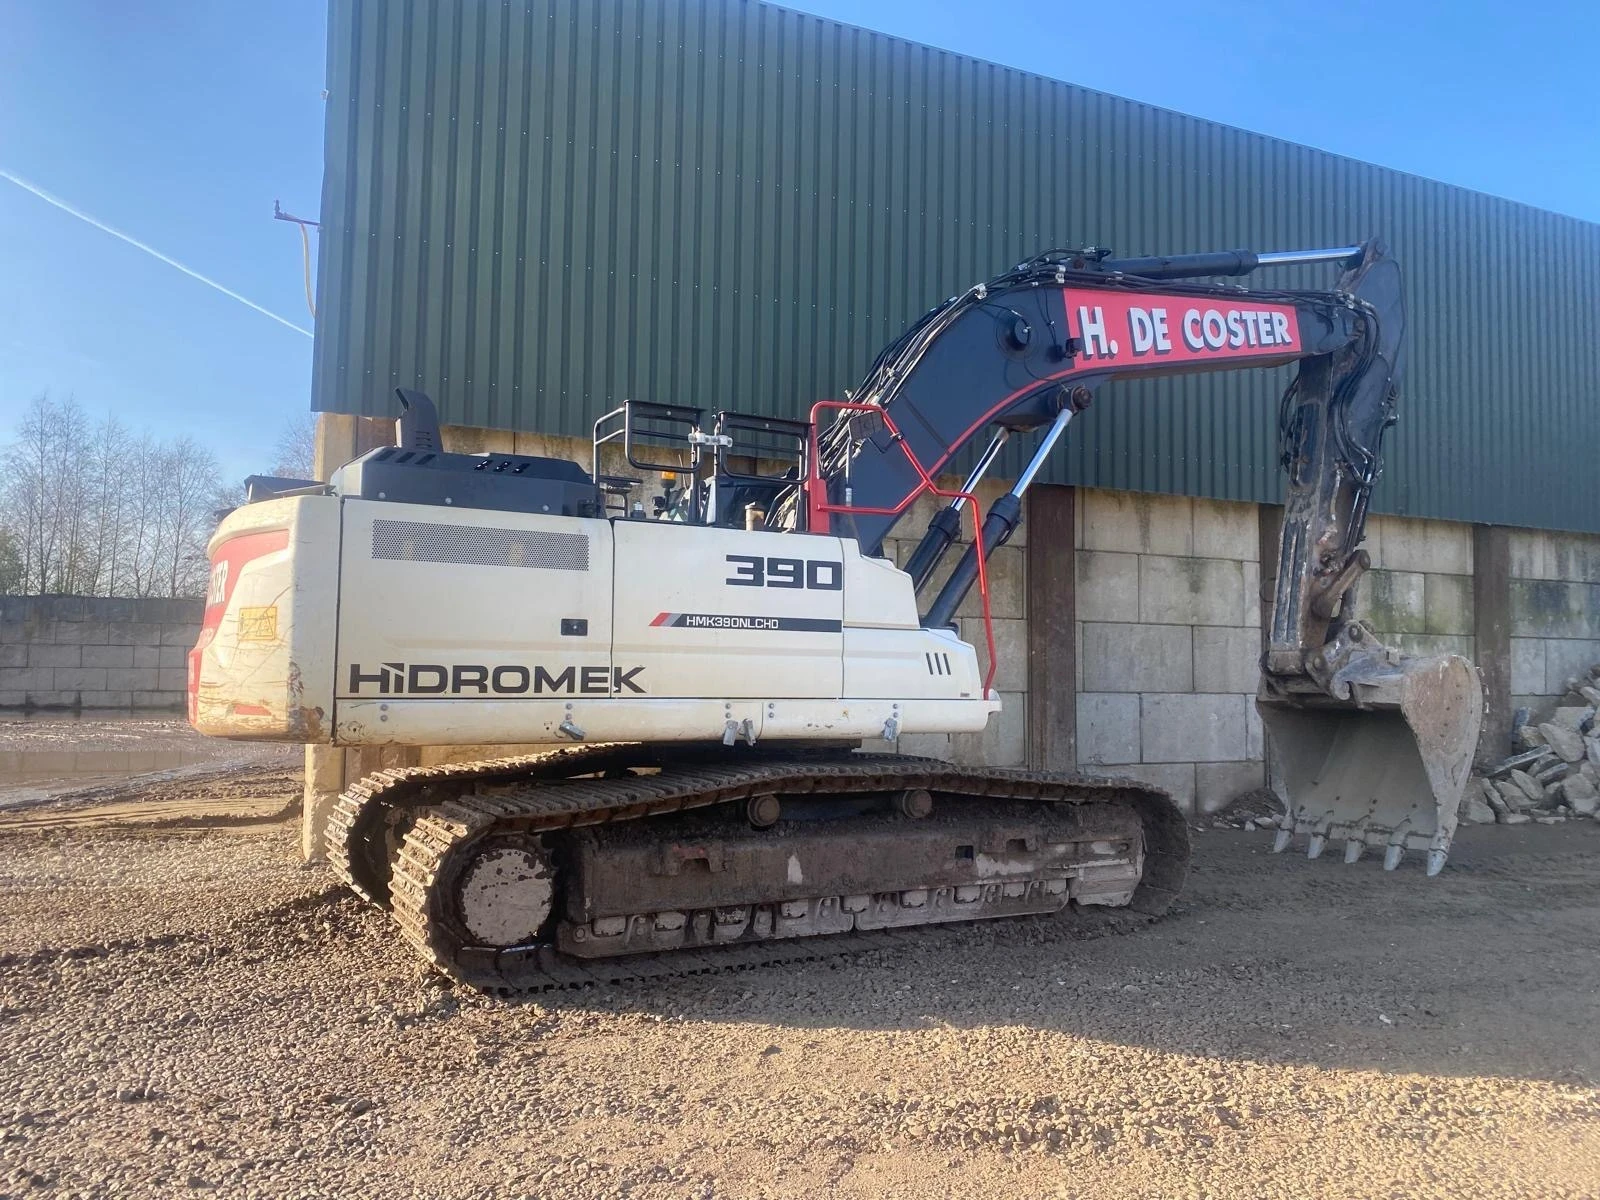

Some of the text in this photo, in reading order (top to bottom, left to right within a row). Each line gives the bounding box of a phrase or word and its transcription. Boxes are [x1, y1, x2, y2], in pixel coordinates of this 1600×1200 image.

[1078, 306, 1293, 358] H. DE COSTER
[725, 554, 843, 591] 390
[685, 615, 779, 629] HMK390NLCHD
